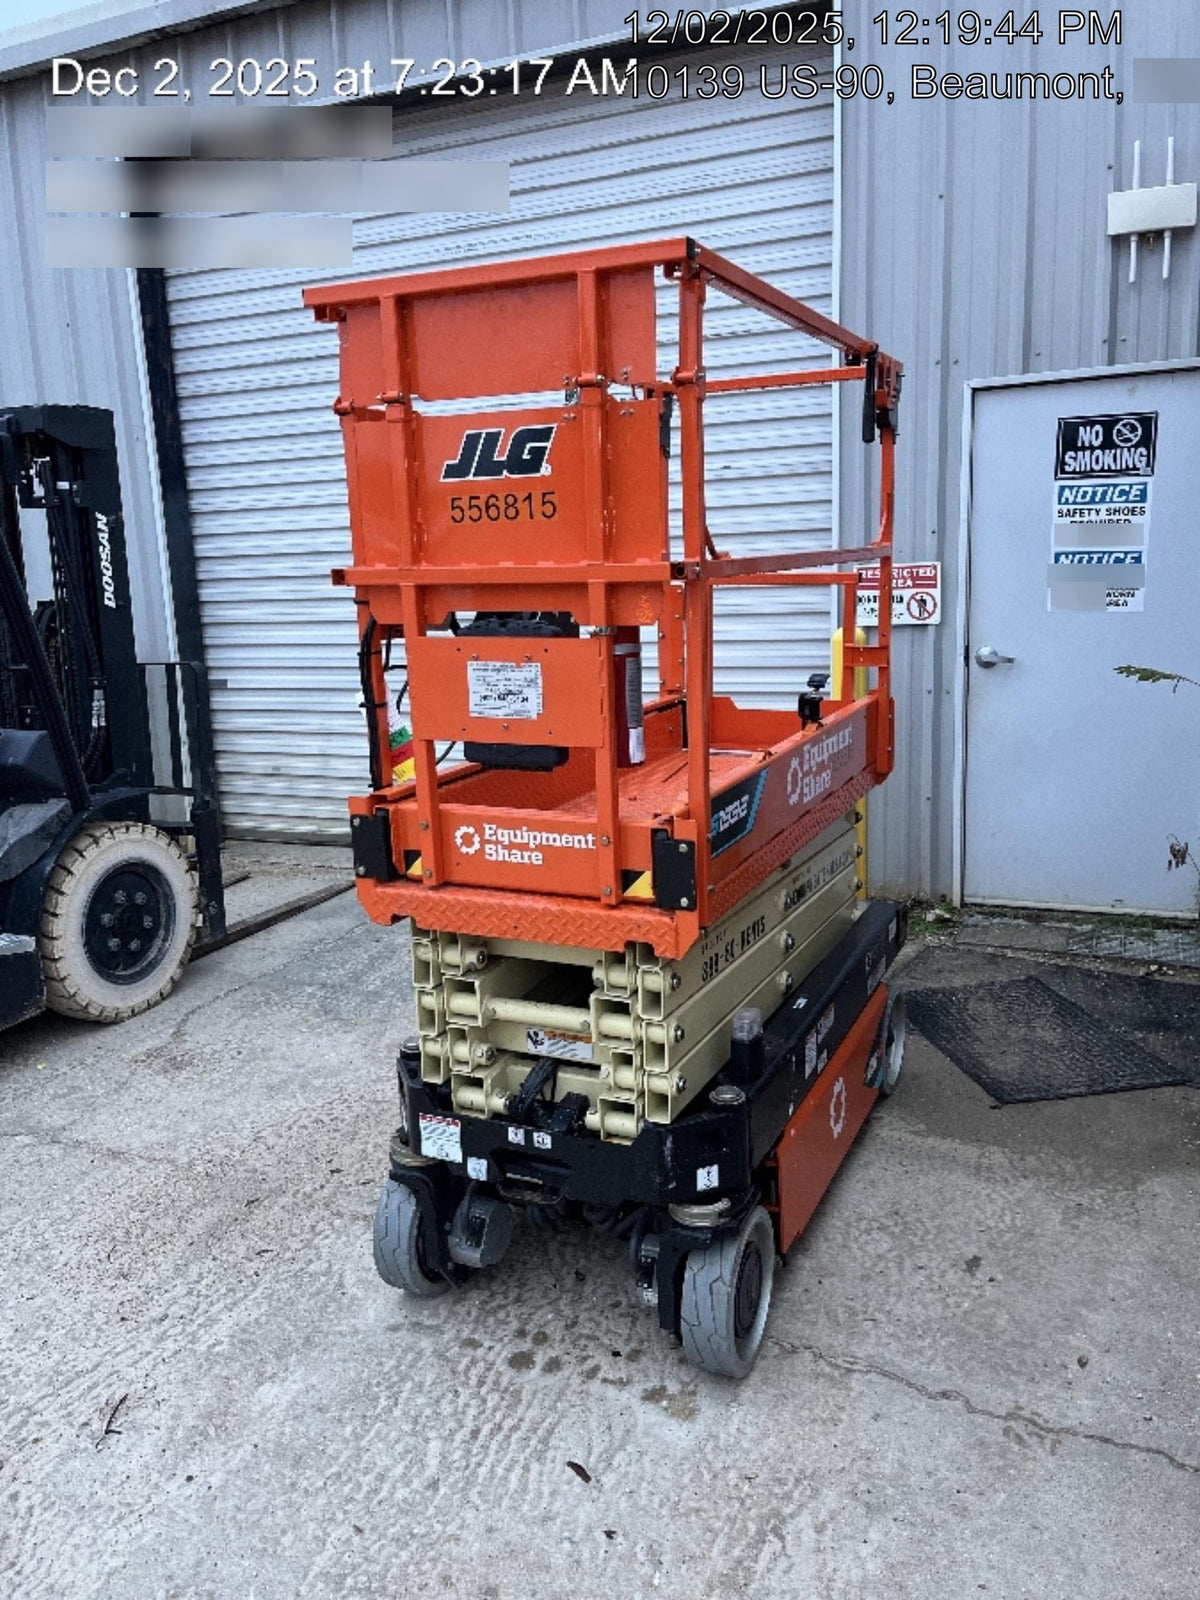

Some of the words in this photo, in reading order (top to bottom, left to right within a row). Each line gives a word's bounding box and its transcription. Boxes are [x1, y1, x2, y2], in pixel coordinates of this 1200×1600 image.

[1077, 425, 1103, 447] NO
[440, 424, 557, 482] JLG
[1064, 447, 1148, 472] SMOKING
[1060, 485, 1146, 503] NOTICE
[450, 491, 557, 524] 556815
[1057, 507, 1101, 518] SAFETY
[1105, 506, 1146, 517] SHOES
[95, 511, 116, 609] DOOSAN
[858, 566, 936, 579] RESRICTED
[483, 823, 597, 850] Equipment
[484, 844, 543, 865] Share
